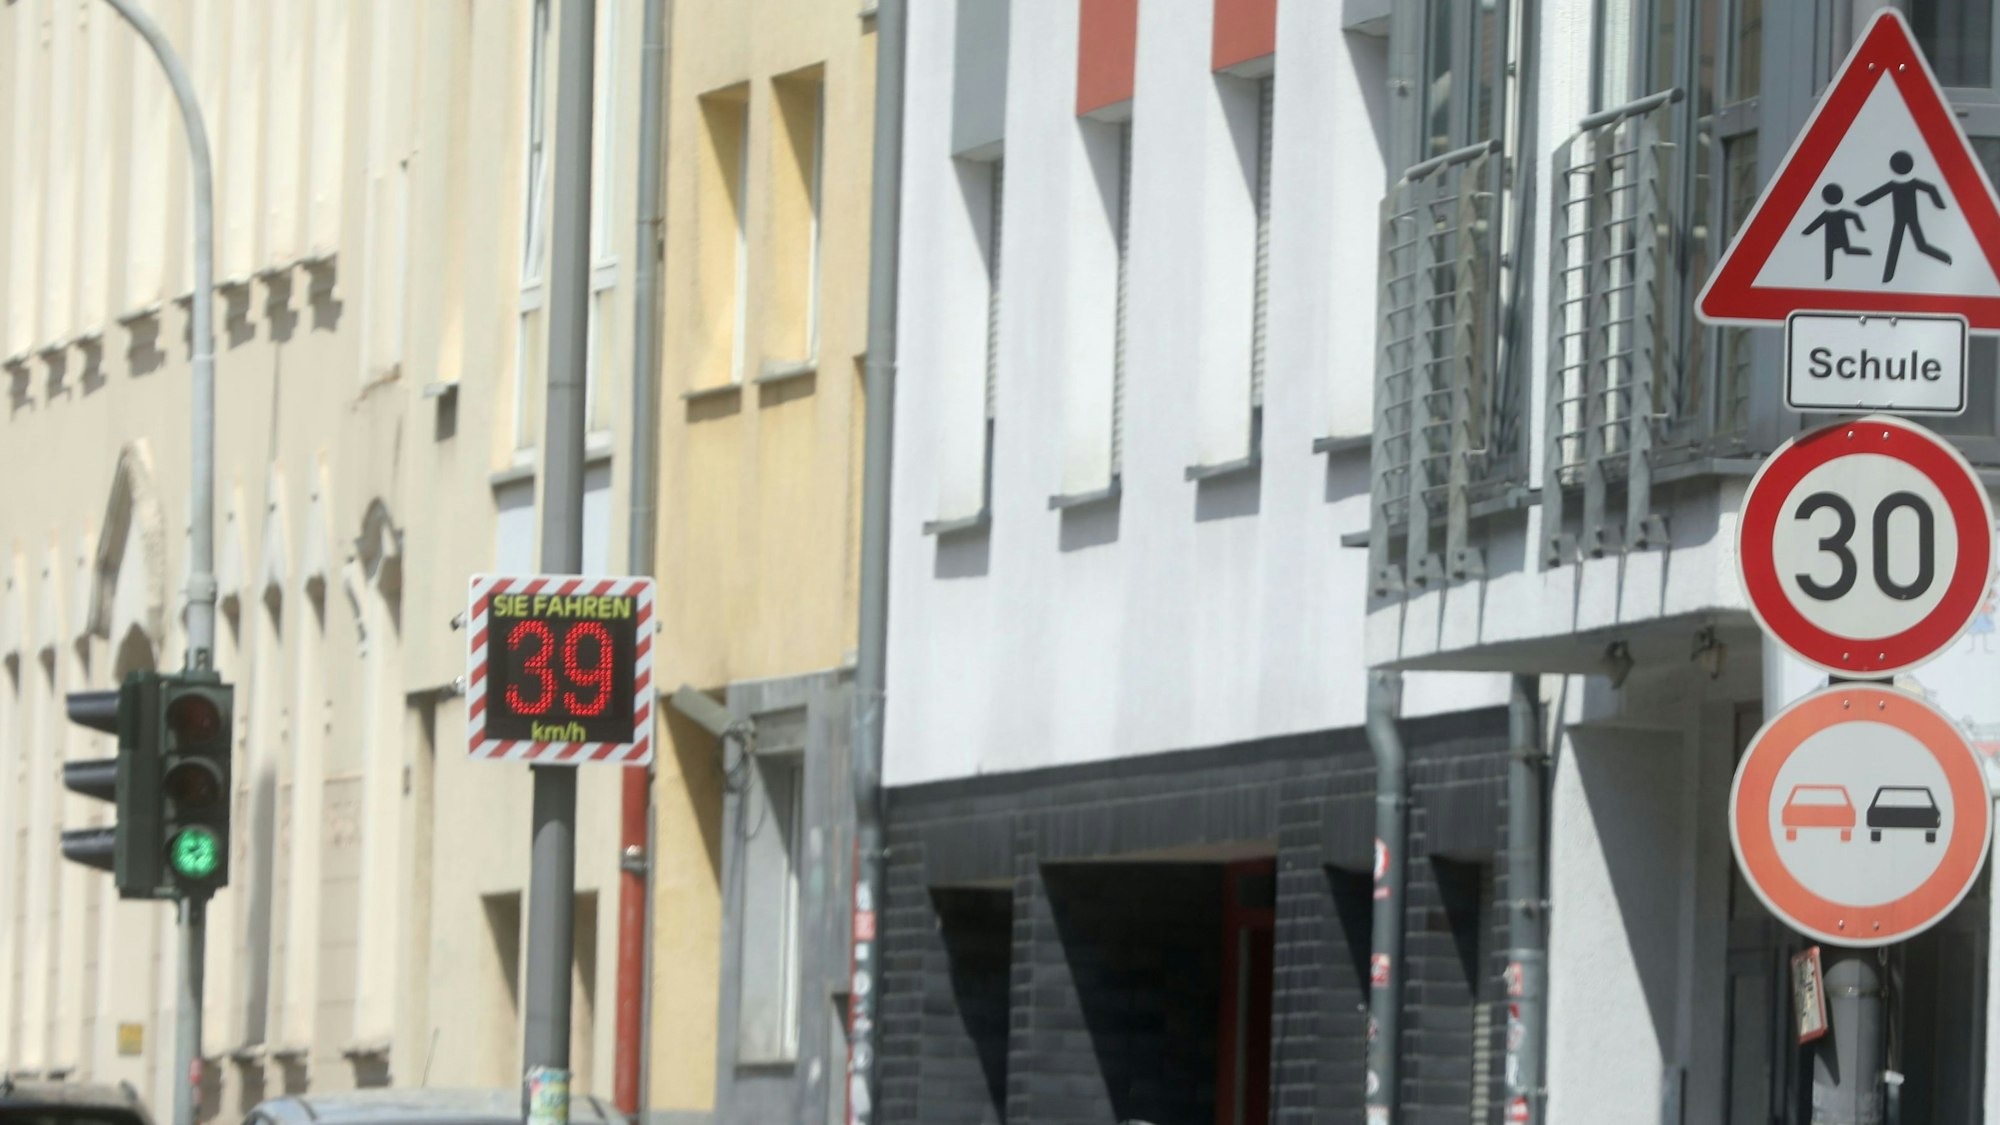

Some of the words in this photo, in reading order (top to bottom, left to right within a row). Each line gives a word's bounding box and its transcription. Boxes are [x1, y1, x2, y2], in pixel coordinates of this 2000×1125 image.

[1808, 347, 1942, 381] Schule
[1794, 491, 1935, 601] 30
[493, 595, 528, 618] SIE
[533, 596, 631, 618] FAHREN
[506, 620, 614, 716] 39
[531, 720, 586, 742] km/h
